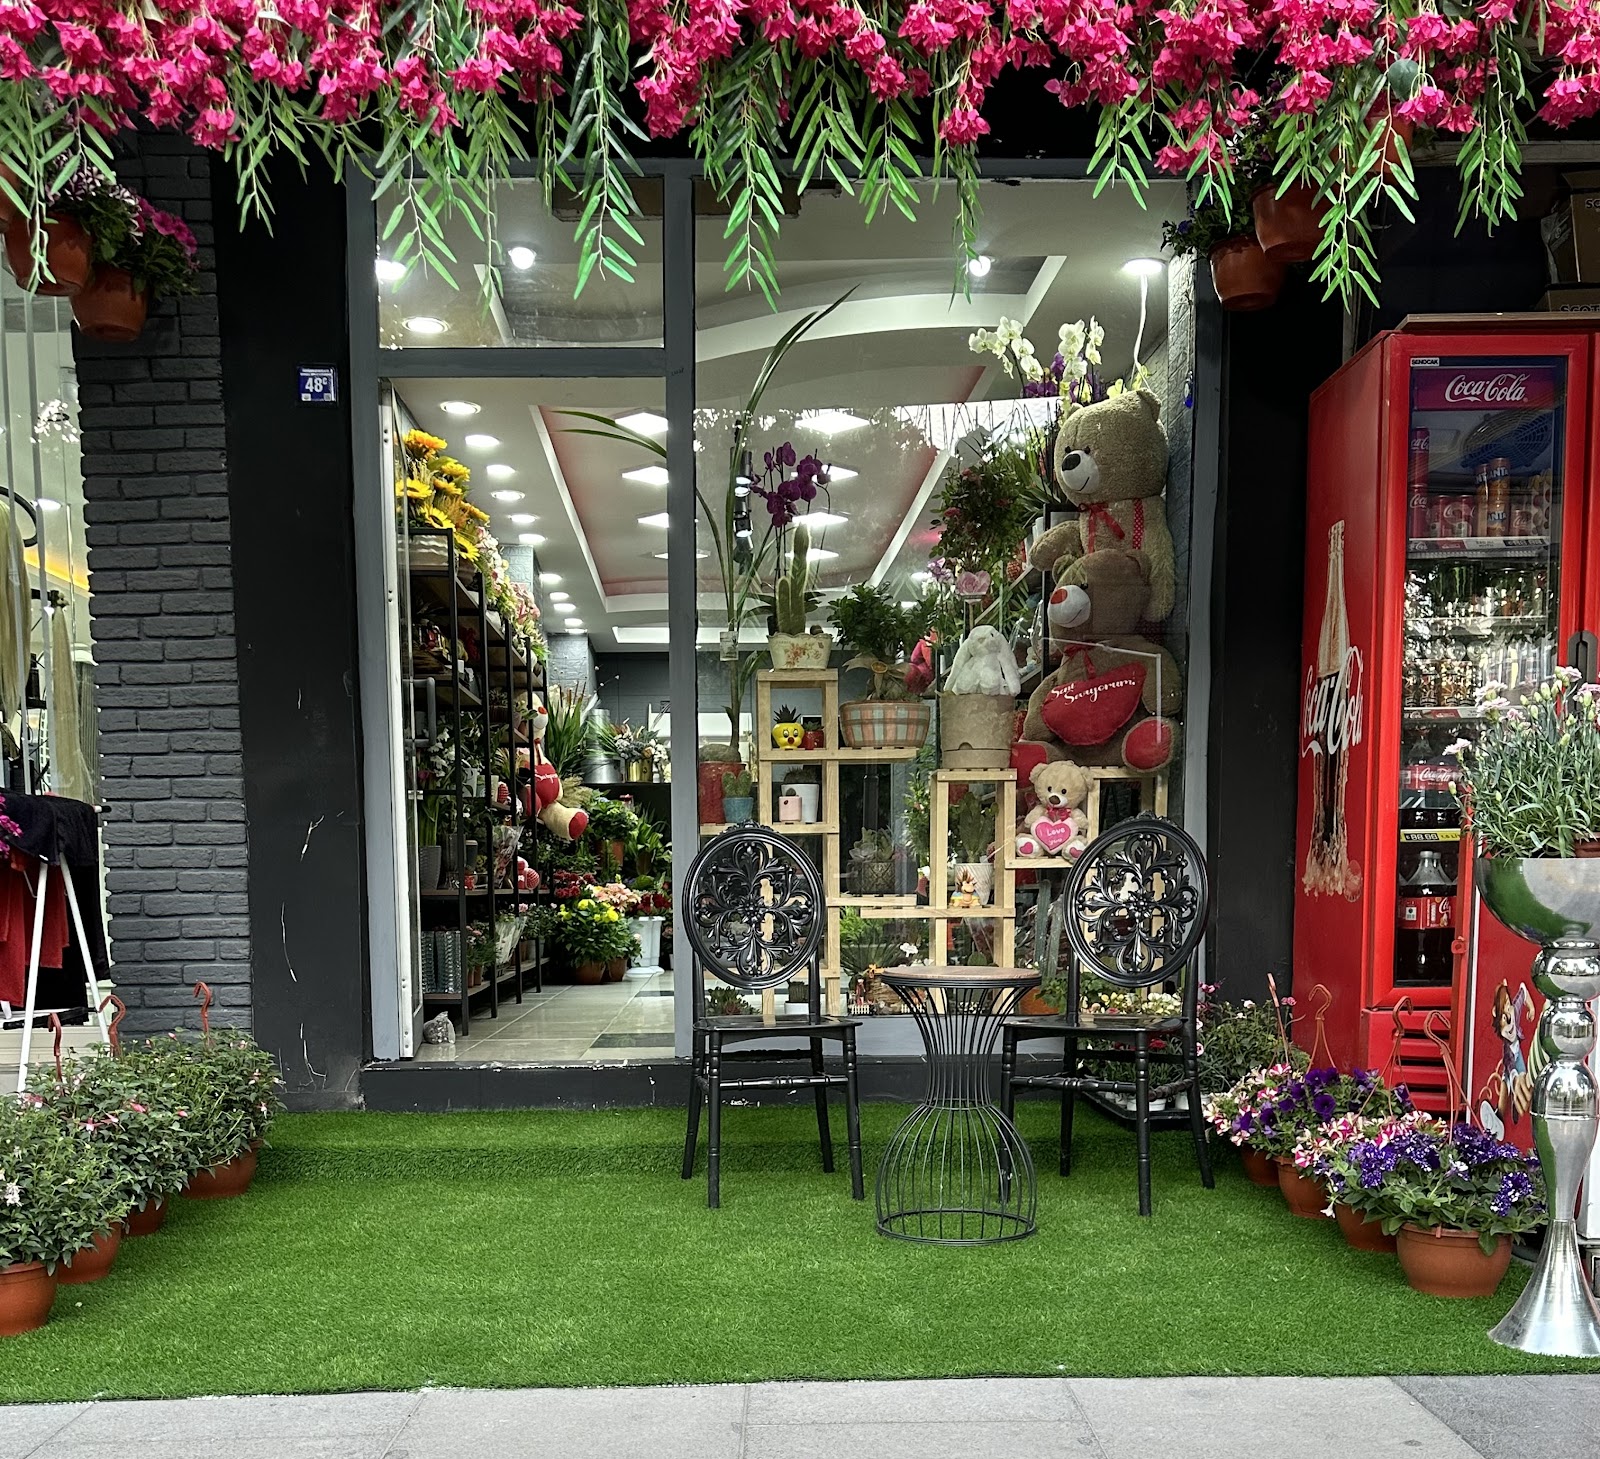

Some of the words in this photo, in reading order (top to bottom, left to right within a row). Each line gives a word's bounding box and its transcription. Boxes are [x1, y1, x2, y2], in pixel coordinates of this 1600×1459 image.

[1445, 373, 1530, 402] Coca-Cola
[1302, 645, 1364, 758] Coca-Cola
[1046, 827, 1066, 837] Love
